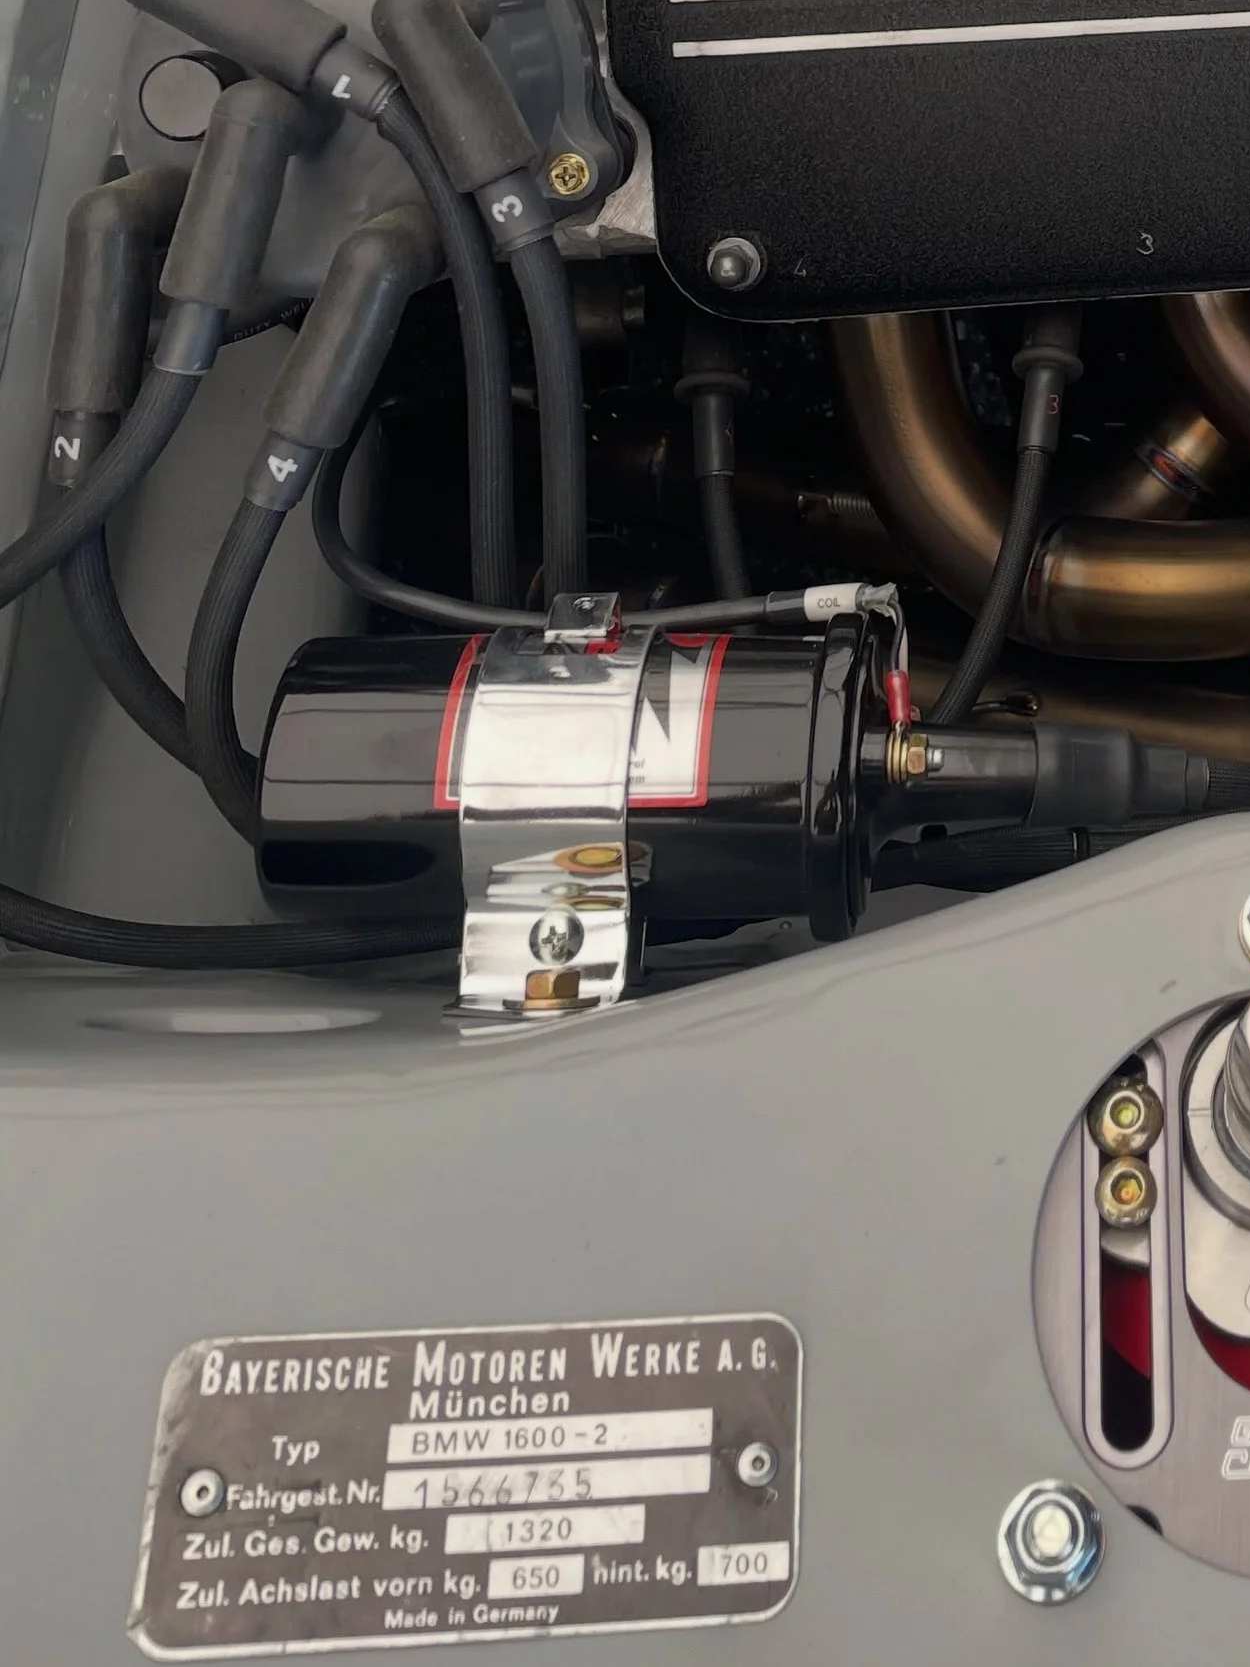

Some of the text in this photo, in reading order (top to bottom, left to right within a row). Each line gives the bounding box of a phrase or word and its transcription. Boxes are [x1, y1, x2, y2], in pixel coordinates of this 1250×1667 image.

[491, 194, 524, 223] 3
[1135, 233, 1155, 255] 3
[793, 256, 807, 278] 4
[1046, 394, 1061, 415] 3
[54, 435, 81, 461] 2
[267, 455, 299, 483] 4
[816, 596, 842, 609] COIL
[200, 1348, 391, 1396] BAYERISCHE
[412, 1339, 567, 1387] MOTOREN
[590, 1331, 701, 1379] WERKE
[409, 1386, 570, 1420] München
[272, 1434, 321, 1466] Typ
[411, 1429, 490, 1455] BMW
[182, 1516, 573, 1560] Zul. Ges. Gew. kg. 1320
[175, 1551, 768, 1609] Zul. Achslast vorn kg. 650 hint. kg. 700
[383, 1602, 561, 1630] Made in Germany
